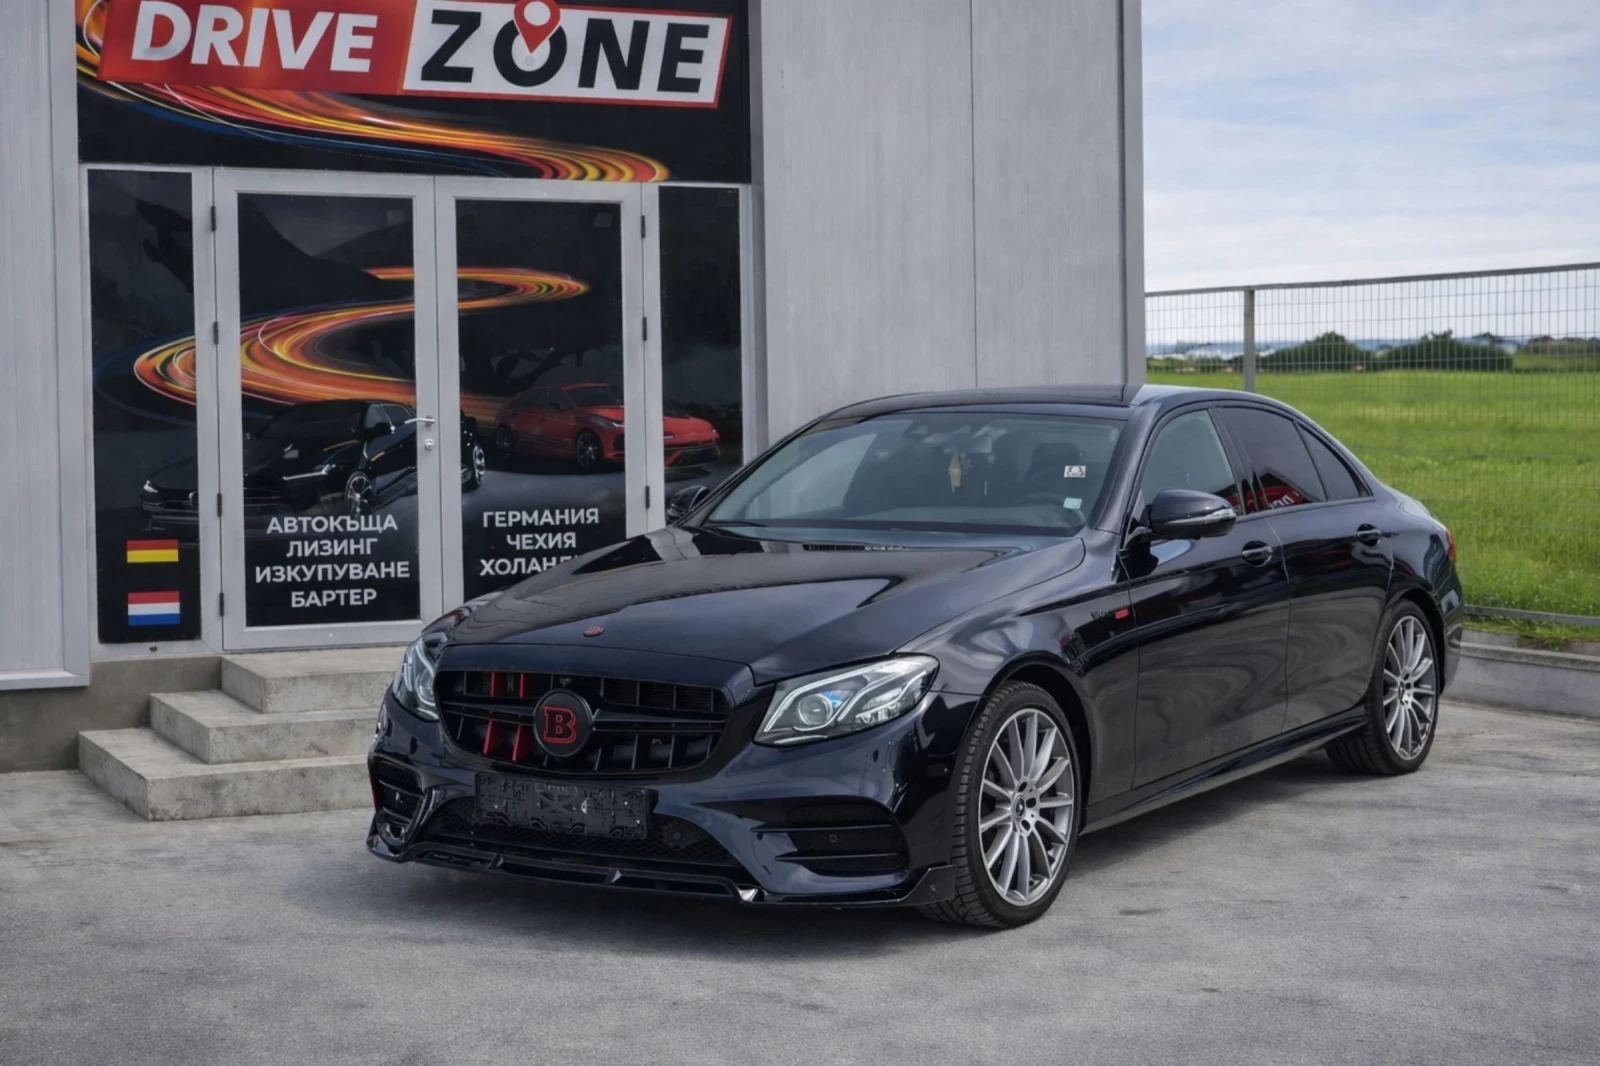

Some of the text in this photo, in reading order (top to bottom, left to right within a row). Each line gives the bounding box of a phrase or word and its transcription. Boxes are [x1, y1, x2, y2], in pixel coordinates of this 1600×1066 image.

[131, 1, 710, 93] DRIVE ZONE
[266, 514, 398, 534] АВТОКЪЩА
[482, 508, 600, 528] ГЕРМАНИЯ
[286, 538, 378, 558] ЛИЗИНГ
[506, 532, 577, 550] ЧЕХИЯ
[255, 561, 411, 584] ИЗКУПУВАНЕ
[479, 555, 579, 576] ХОЛАН
[290, 588, 378, 608] БАРТЕР
[543, 706, 577, 744] B
